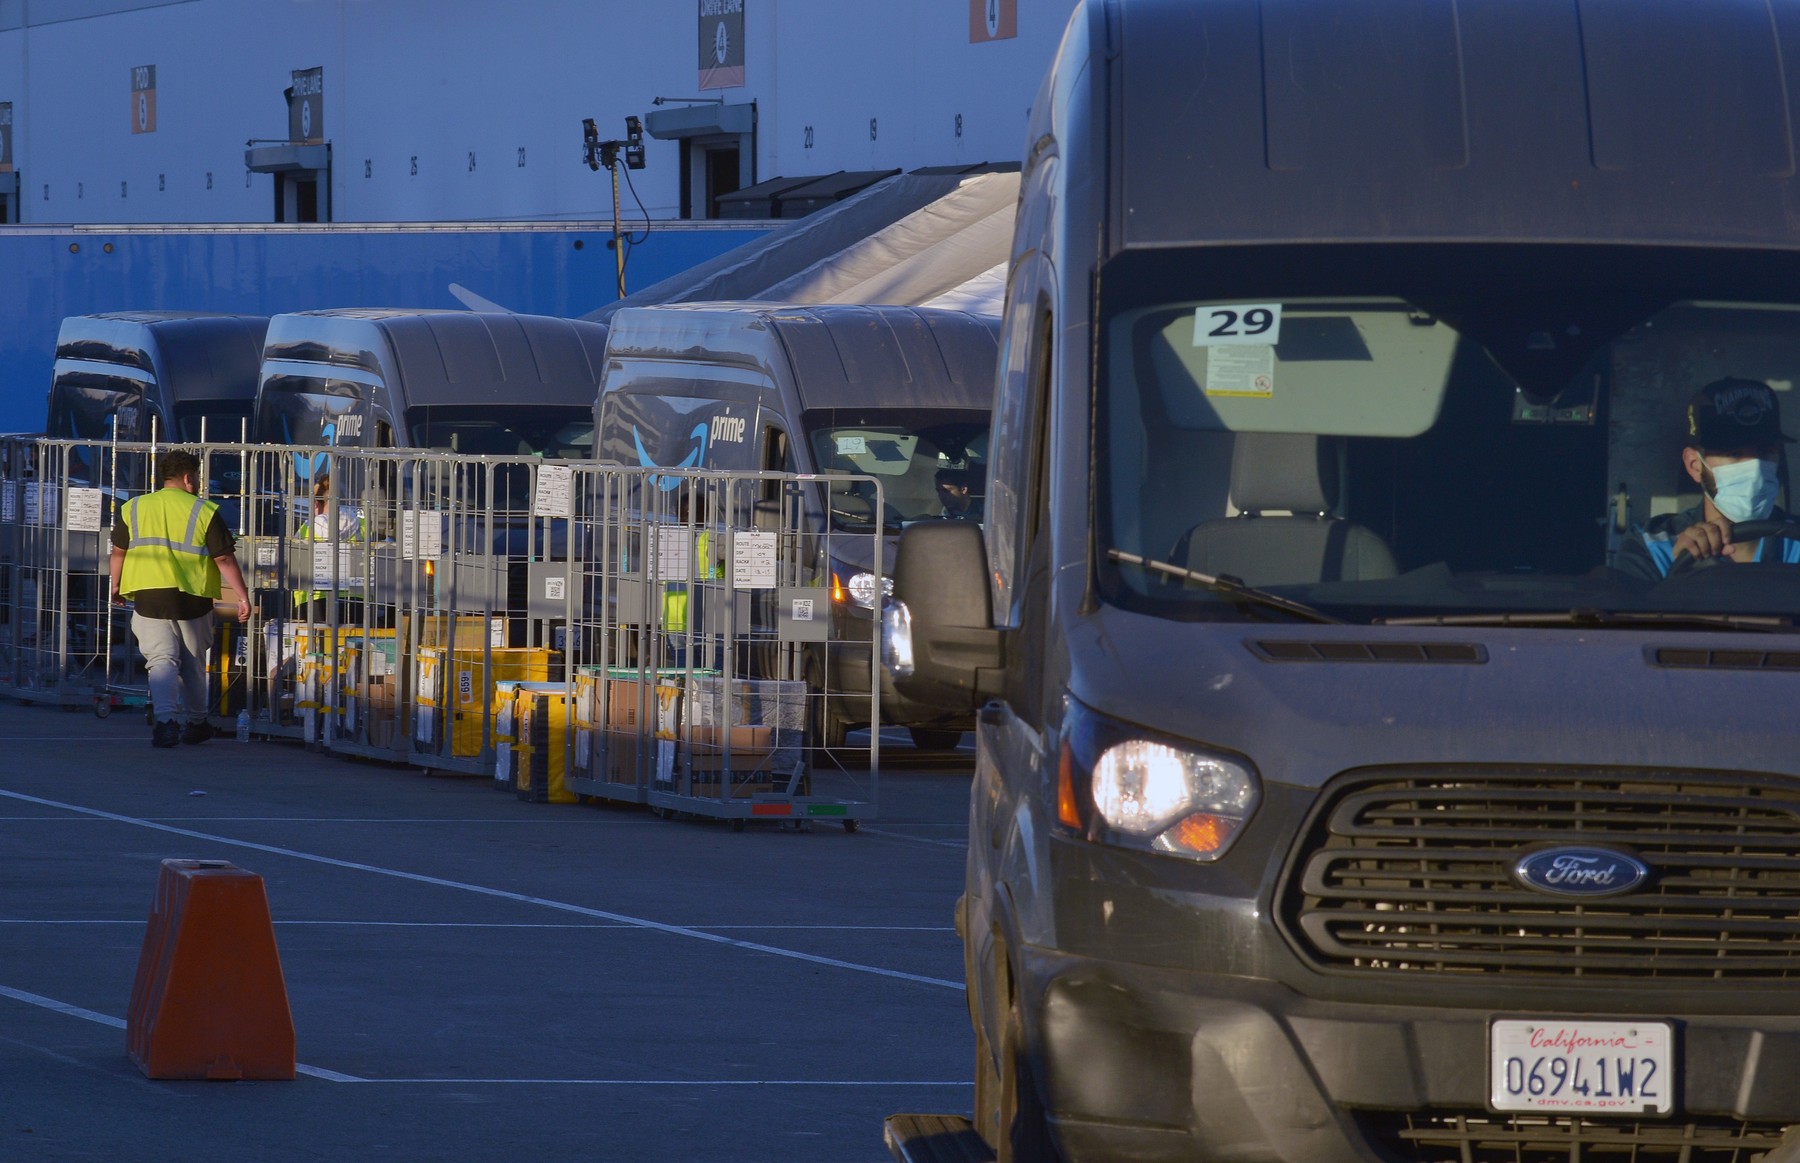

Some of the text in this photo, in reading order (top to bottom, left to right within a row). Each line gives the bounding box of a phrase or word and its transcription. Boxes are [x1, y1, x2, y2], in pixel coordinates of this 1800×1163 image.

[701, 0, 742, 17] DRIVE LANE
[135, 67, 149, 89] POD
[308, 74, 321, 94] LANE
[870, 117, 877, 141] 19
[955, 113, 962, 138] 18
[804, 126, 814, 149] 20
[410, 156, 418, 176] 25
[468, 152, 476, 172] 24
[517, 147, 526, 167] 23
[365, 159, 372, 179] 26
[1208, 308, 1274, 337] 29
[335, 406, 363, 444] prime
[709, 407, 745, 449] prime
[843, 437, 862, 450] 19
[460, 676, 470, 693] 659
[1546, 854, 1616, 885] Ford
[1530, 1028, 1637, 1055] California
[1507, 1056, 1658, 1097] 06941W2
[1537, 1098, 1627, 1108] dmv.ca.gov
